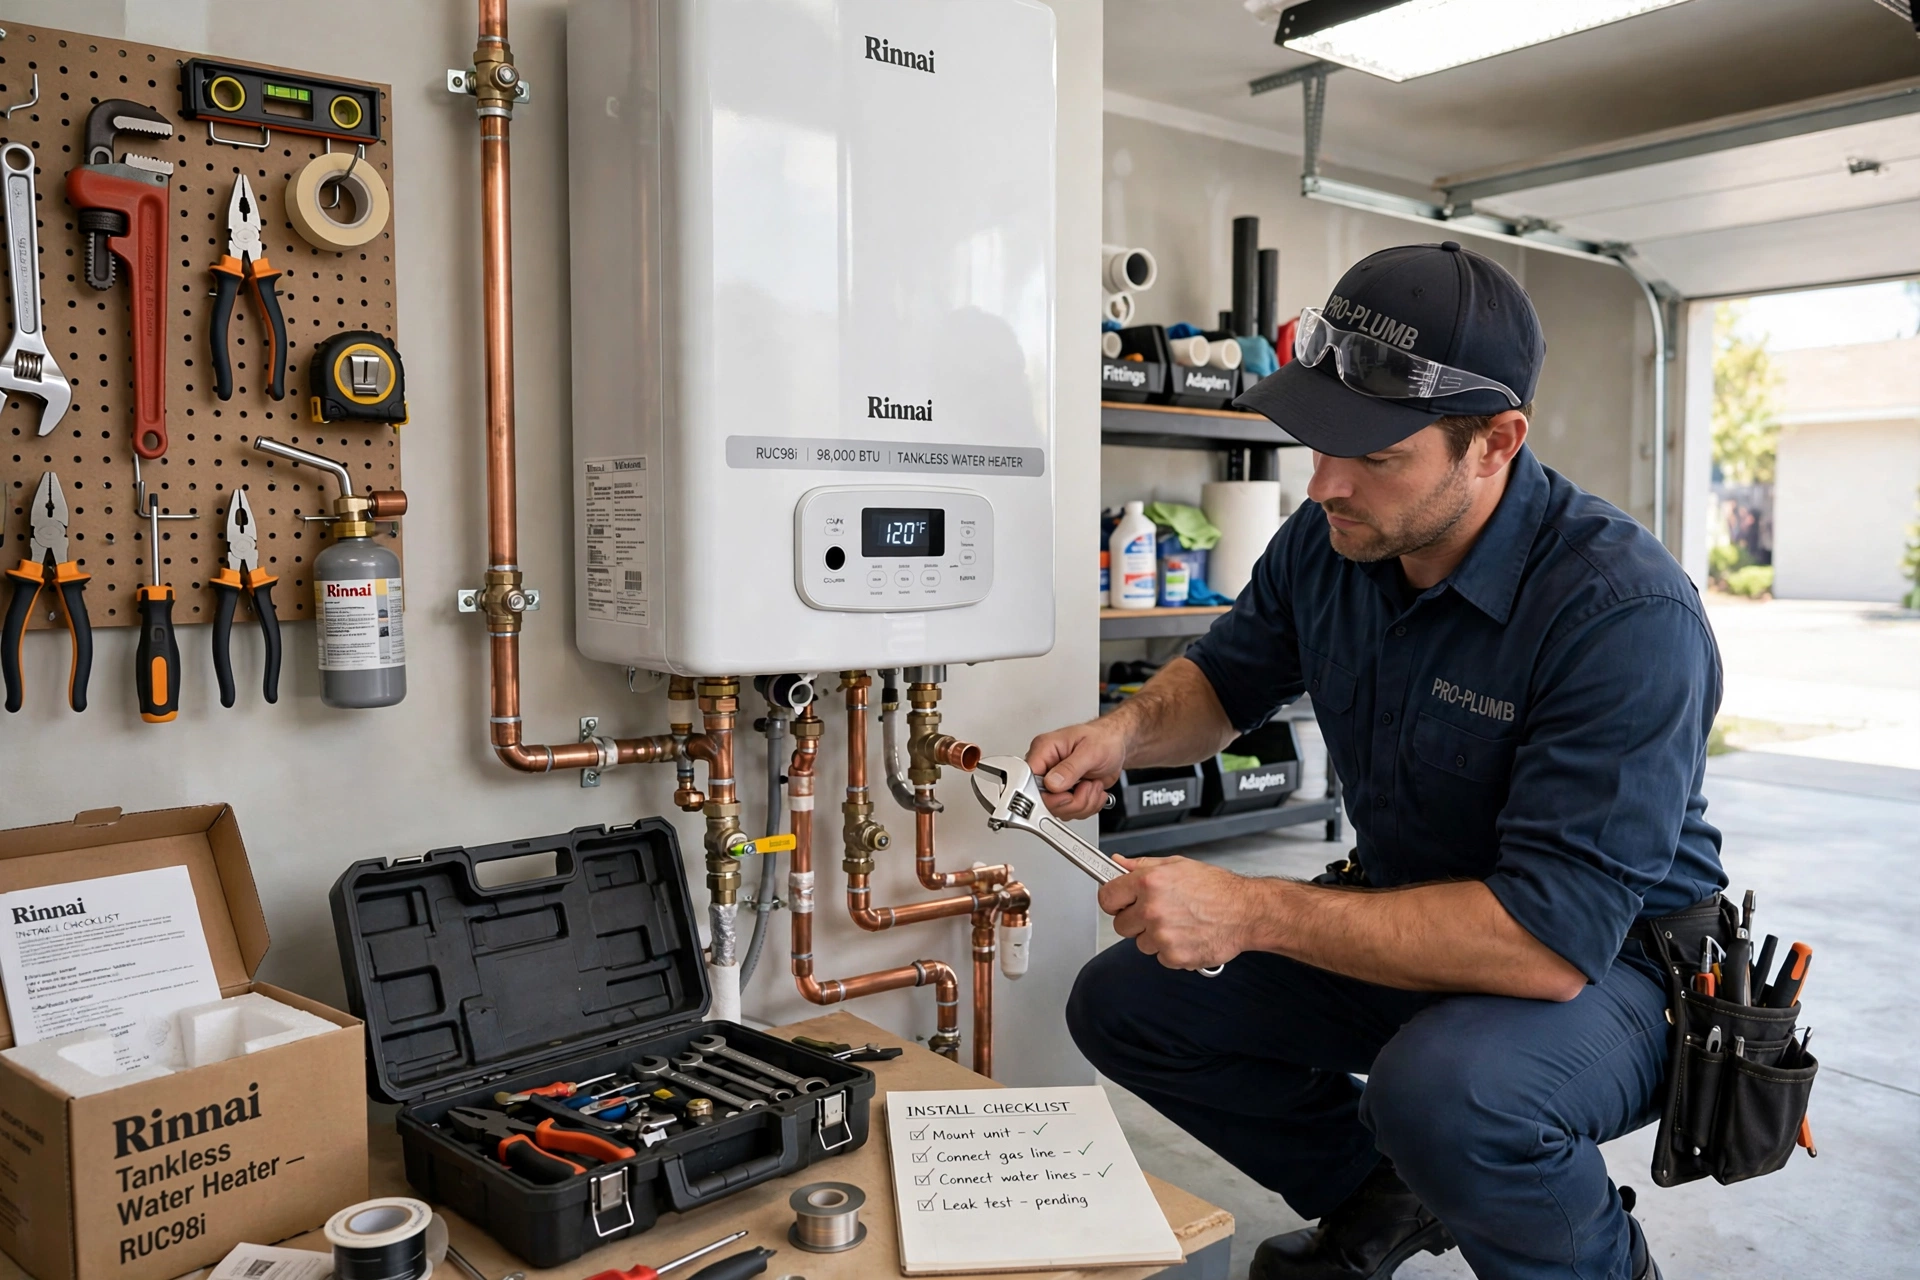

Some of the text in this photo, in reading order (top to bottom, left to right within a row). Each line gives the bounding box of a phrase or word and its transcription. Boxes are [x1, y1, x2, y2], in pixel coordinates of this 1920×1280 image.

[864, 35, 936, 74] Rinnai
[1324, 295, 1419, 350] PRO-PLUMB
[1103, 365, 1146, 387] Fittings
[867, 396, 933, 421] Rinnai
[756, 447, 1023, 469] RUC98i 98,000 BTU TANKLESS WATER HEATER
[327, 584, 372, 598] Rinnai
[1431, 677, 1515, 722] PRO-PLUMB
[1239, 772, 1286, 792] Adapters
[1142, 787, 1186, 807] Fittings
[11, 897, 86, 925] Rinnai
[112, 1082, 262, 1160] Rinnai
[906, 1104, 975, 1117] INSTALL
[933, 1129, 976, 1141] Mount
[983, 1128, 1011, 1139] unit
[936, 1150, 991, 1163] Connect
[999, 1152, 1024, 1165] gas
[1030, 1147, 1056, 1159] line
[116, 1143, 231, 1193] Tankless
[939, 1172, 993, 1186] Connect
[1001, 1171, 1039, 1182] water
[1045, 1169, 1077, 1180] lines
[117, 1185, 195, 1226] Water
[203, 1156, 280, 1198] Heater
[943, 1198, 978, 1211] Leak
[984, 1197, 1013, 1209] test
[1035, 1193, 1089, 1211] pending
[120, 1213, 205, 1265] RUC98i
